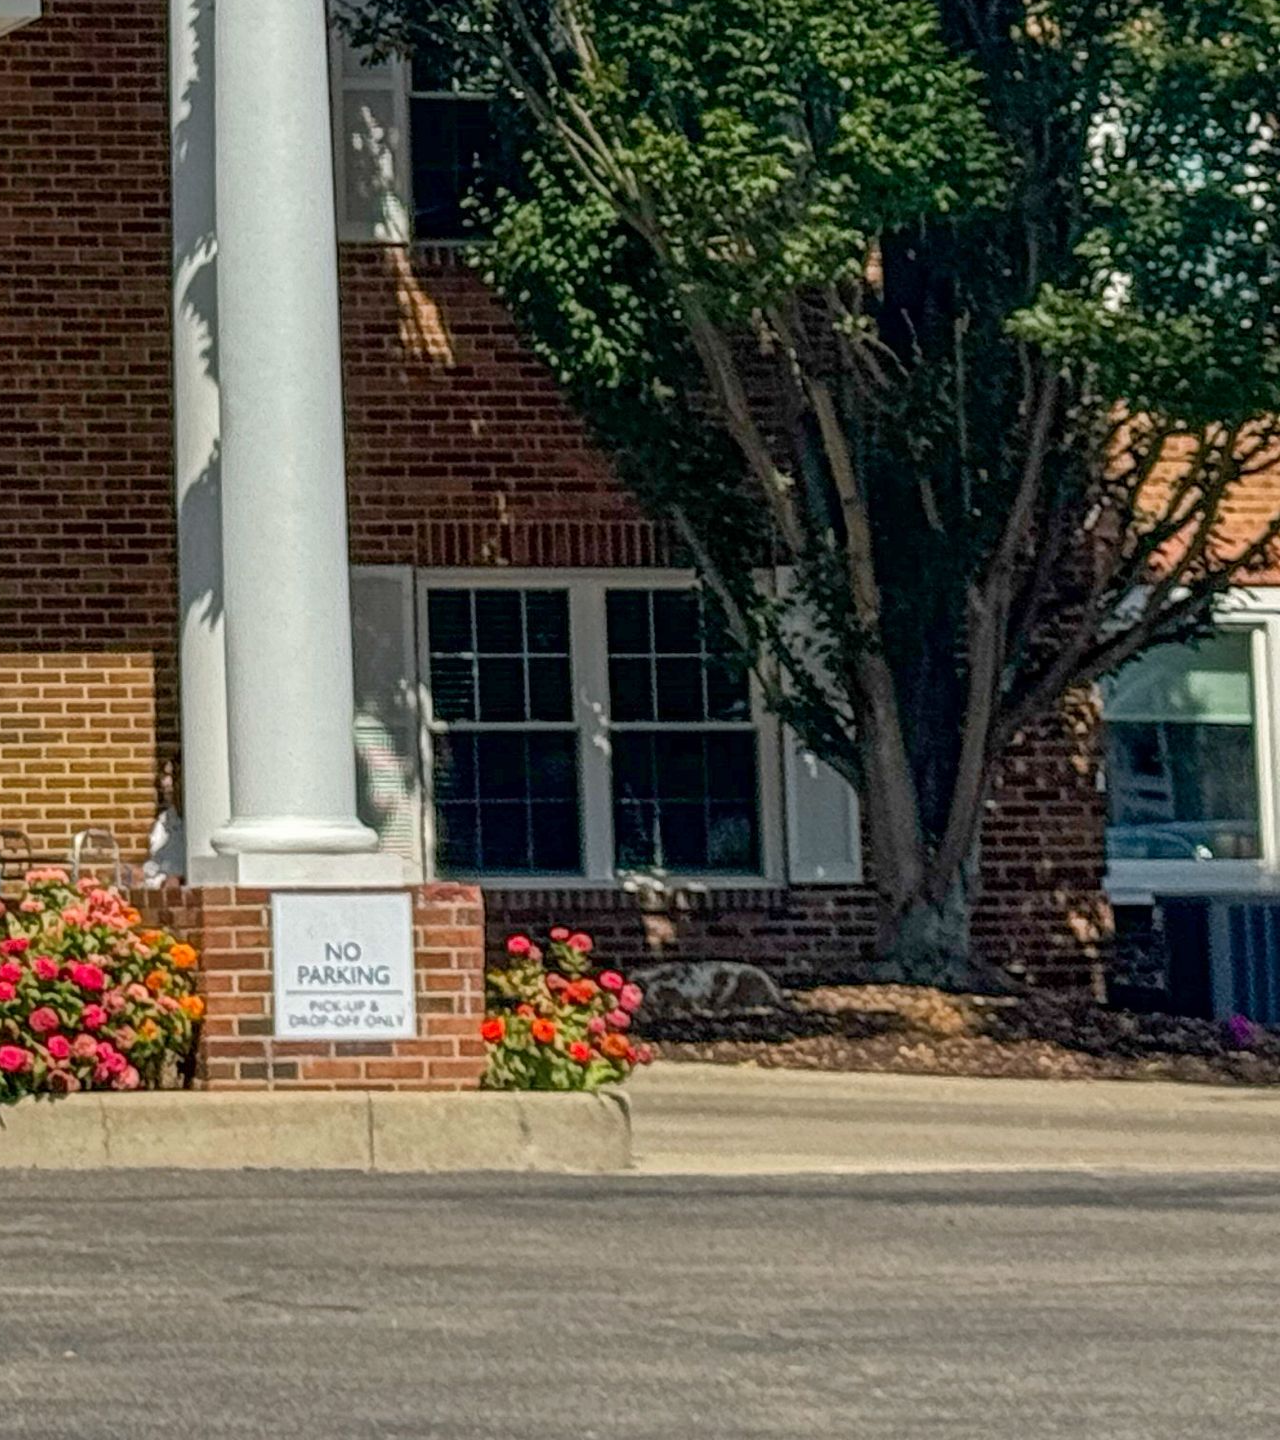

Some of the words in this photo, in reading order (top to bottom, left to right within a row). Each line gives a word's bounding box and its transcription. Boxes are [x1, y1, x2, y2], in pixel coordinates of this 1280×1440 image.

[325, 942, 362, 962] NO
[297, 965, 391, 985] PARKING
[364, 1014, 404, 1028] ONLY
